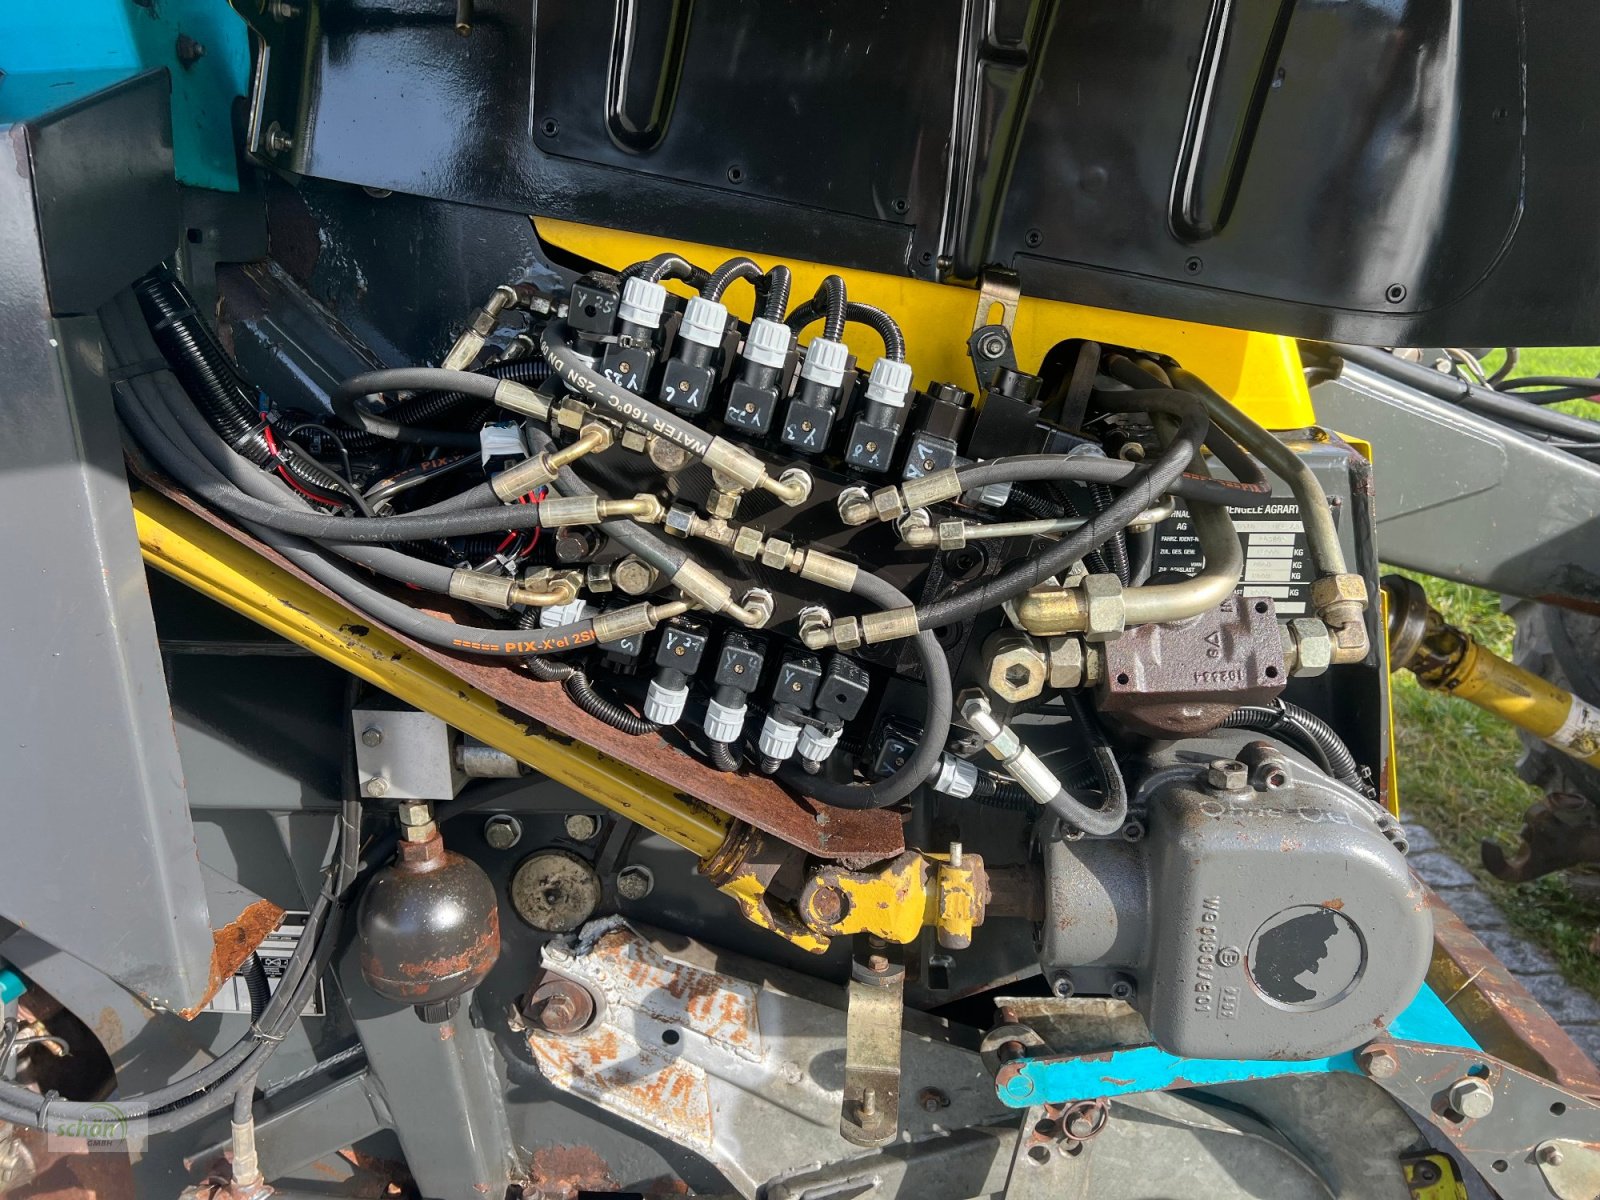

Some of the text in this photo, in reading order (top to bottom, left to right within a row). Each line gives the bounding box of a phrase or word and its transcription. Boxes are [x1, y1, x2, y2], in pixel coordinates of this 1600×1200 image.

[548, 351, 565, 372] DN
[567, 368, 597, 394] 2SN
[652, 418, 707, 455] WATER
[1176, 522, 1188, 531] AG
[1294, 549, 1304, 557] KG
[1292, 561, 1302, 569] KG
[1291, 572, 1301, 580] KG
[1289, 588, 1299, 596] KG
